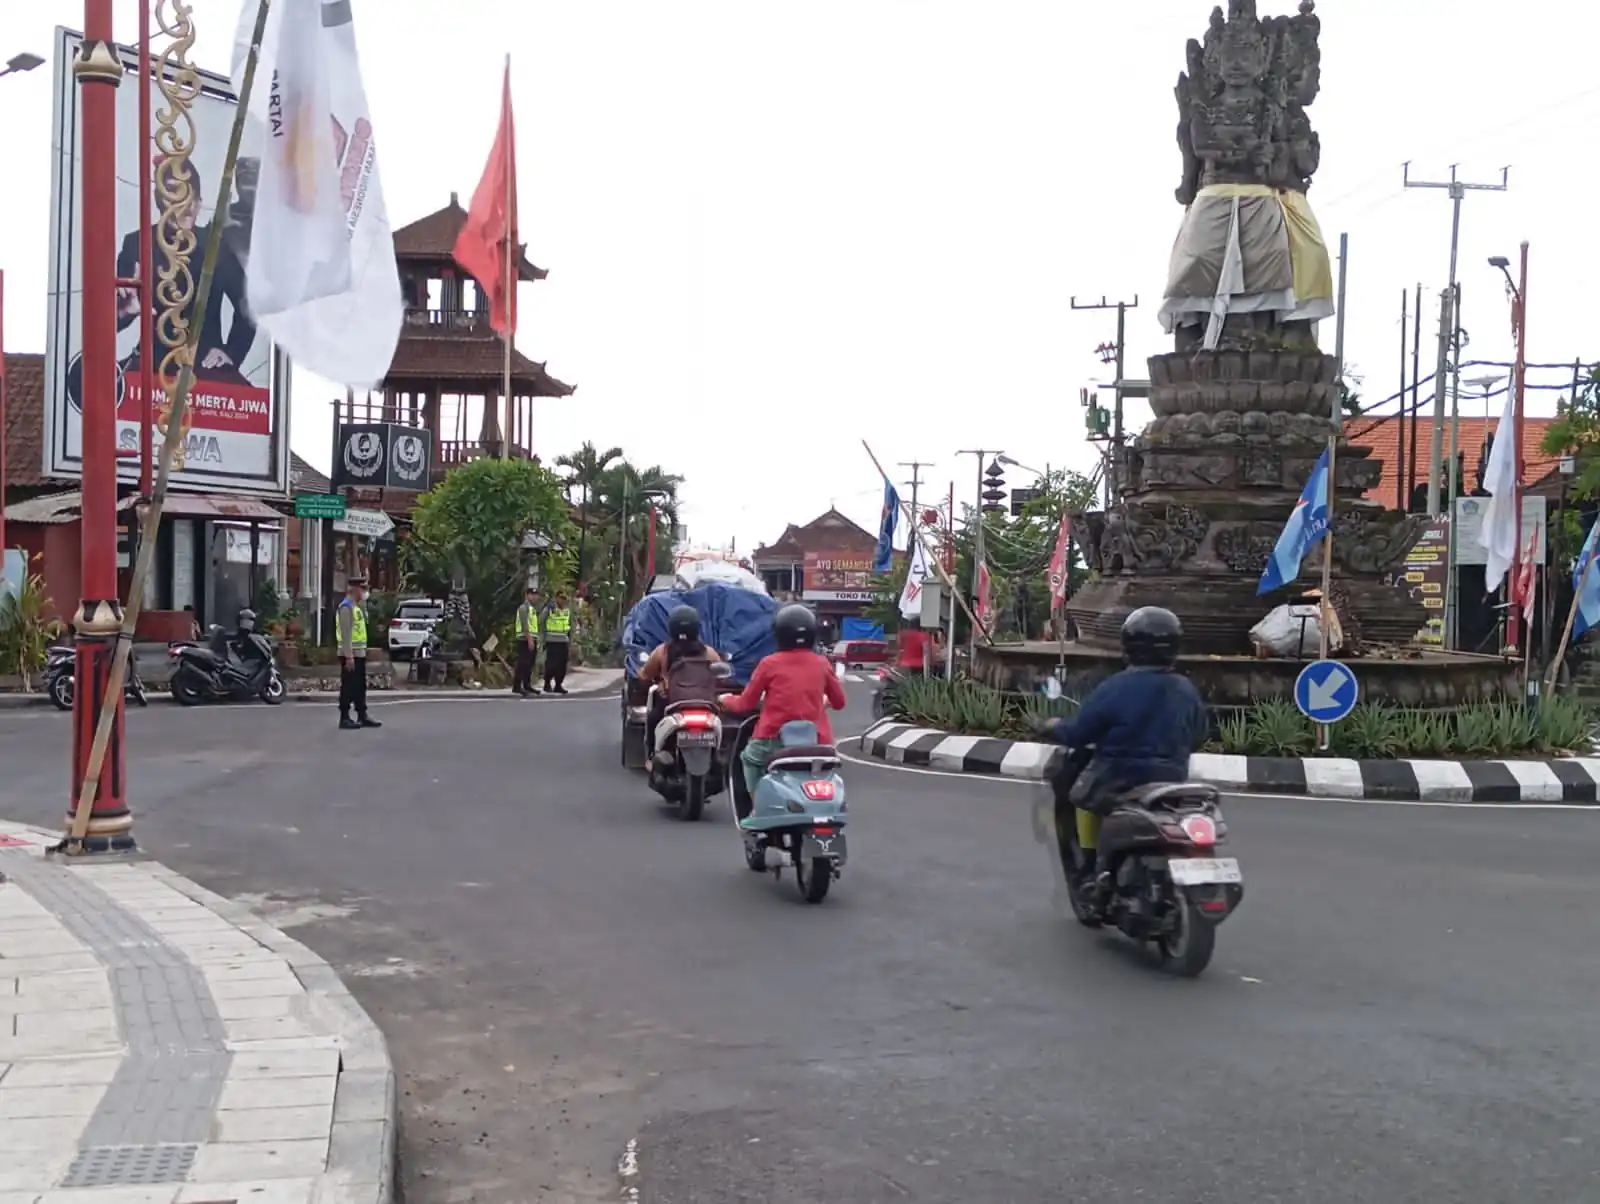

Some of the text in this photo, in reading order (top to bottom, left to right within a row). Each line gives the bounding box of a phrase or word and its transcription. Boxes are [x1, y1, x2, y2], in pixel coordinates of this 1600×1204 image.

[195, 393, 235, 411] MERTA
[238, 398, 268, 415] JIWA
[816, 559, 873, 570] AYO SEMANGAT
[835, 592, 859, 600] TOKO
